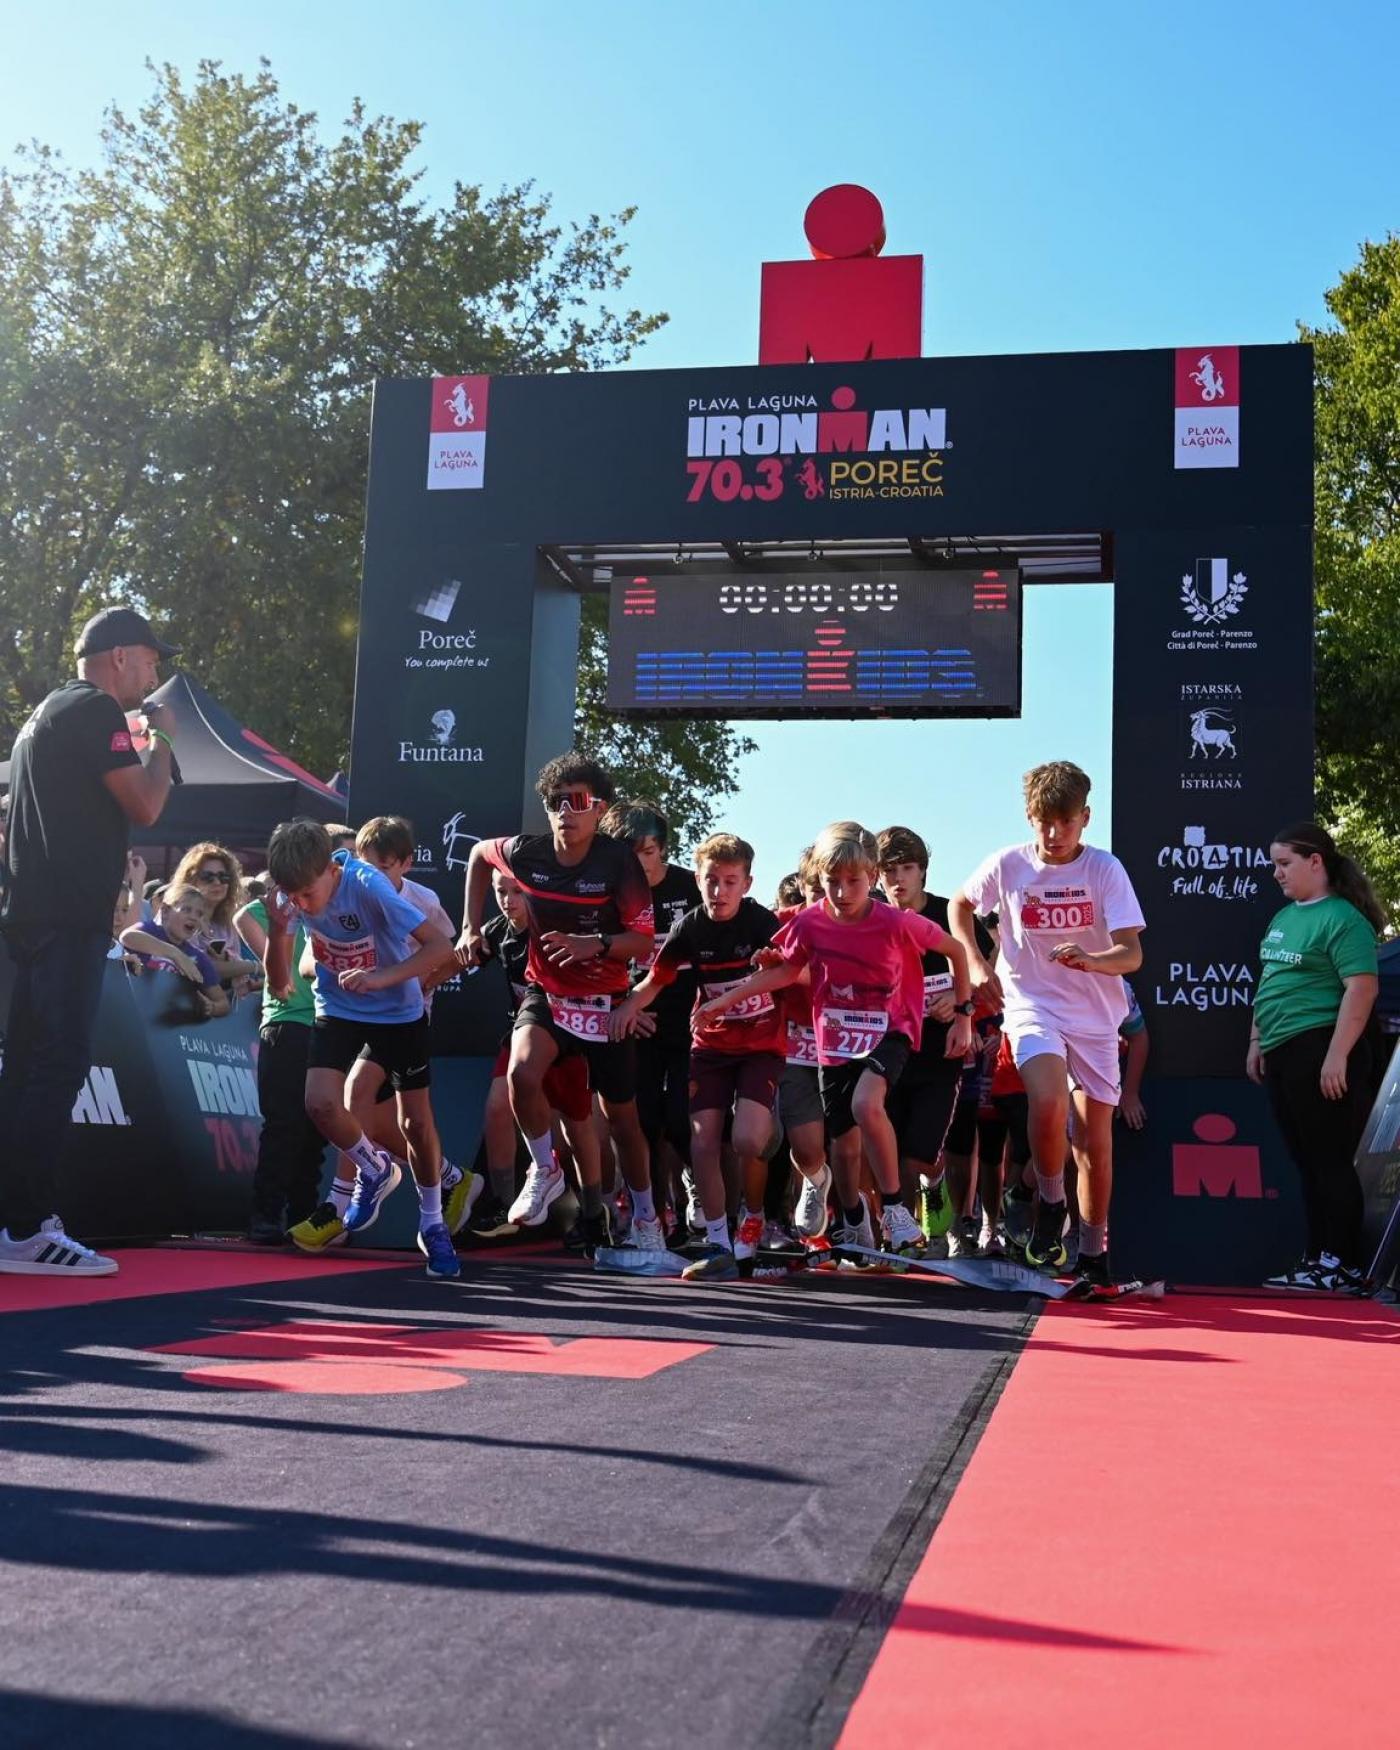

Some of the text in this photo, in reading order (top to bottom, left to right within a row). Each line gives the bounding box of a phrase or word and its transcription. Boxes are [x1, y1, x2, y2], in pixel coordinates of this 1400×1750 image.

[688, 395, 818, 412] PLAVA LAGUNA
[687, 391, 947, 457] IRONMAN
[1187, 426, 1226, 436] PLAVA
[1181, 437, 1232, 448] LAGUNA
[434, 460, 479, 470] LAGUNA
[440, 450, 473, 459] PLAVA
[829, 451, 944, 486] POREČ
[686, 458, 785, 502] 70.3
[418, 629, 477, 650] Poreč
[1171, 630, 1191, 638] Grad
[1220, 629, 1253, 638] Parenzo
[1187, 641, 1195, 649] di
[1224, 641, 1258, 649] Parenzo
[404, 655, 423, 668] You
[425, 654, 475, 671] complete
[1181, 684, 1242, 694] ISTARSKA
[398, 740, 484, 762] Funtana
[1181, 779, 1242, 789] ISTRIANA
[1157, 845, 1273, 870] CROATIA
[1172, 874, 1205, 895] Full
[1232, 875, 1259, 899] life
[1036, 905, 1082, 928] 300
[1169, 963, 1254, 983] PLAVA
[1156, 986, 1254, 1011] LAGUN
[559, 1010, 600, 1034] 286
[180, 1034, 211, 1055] PLAVA
[837, 1031, 874, 1052] 271
